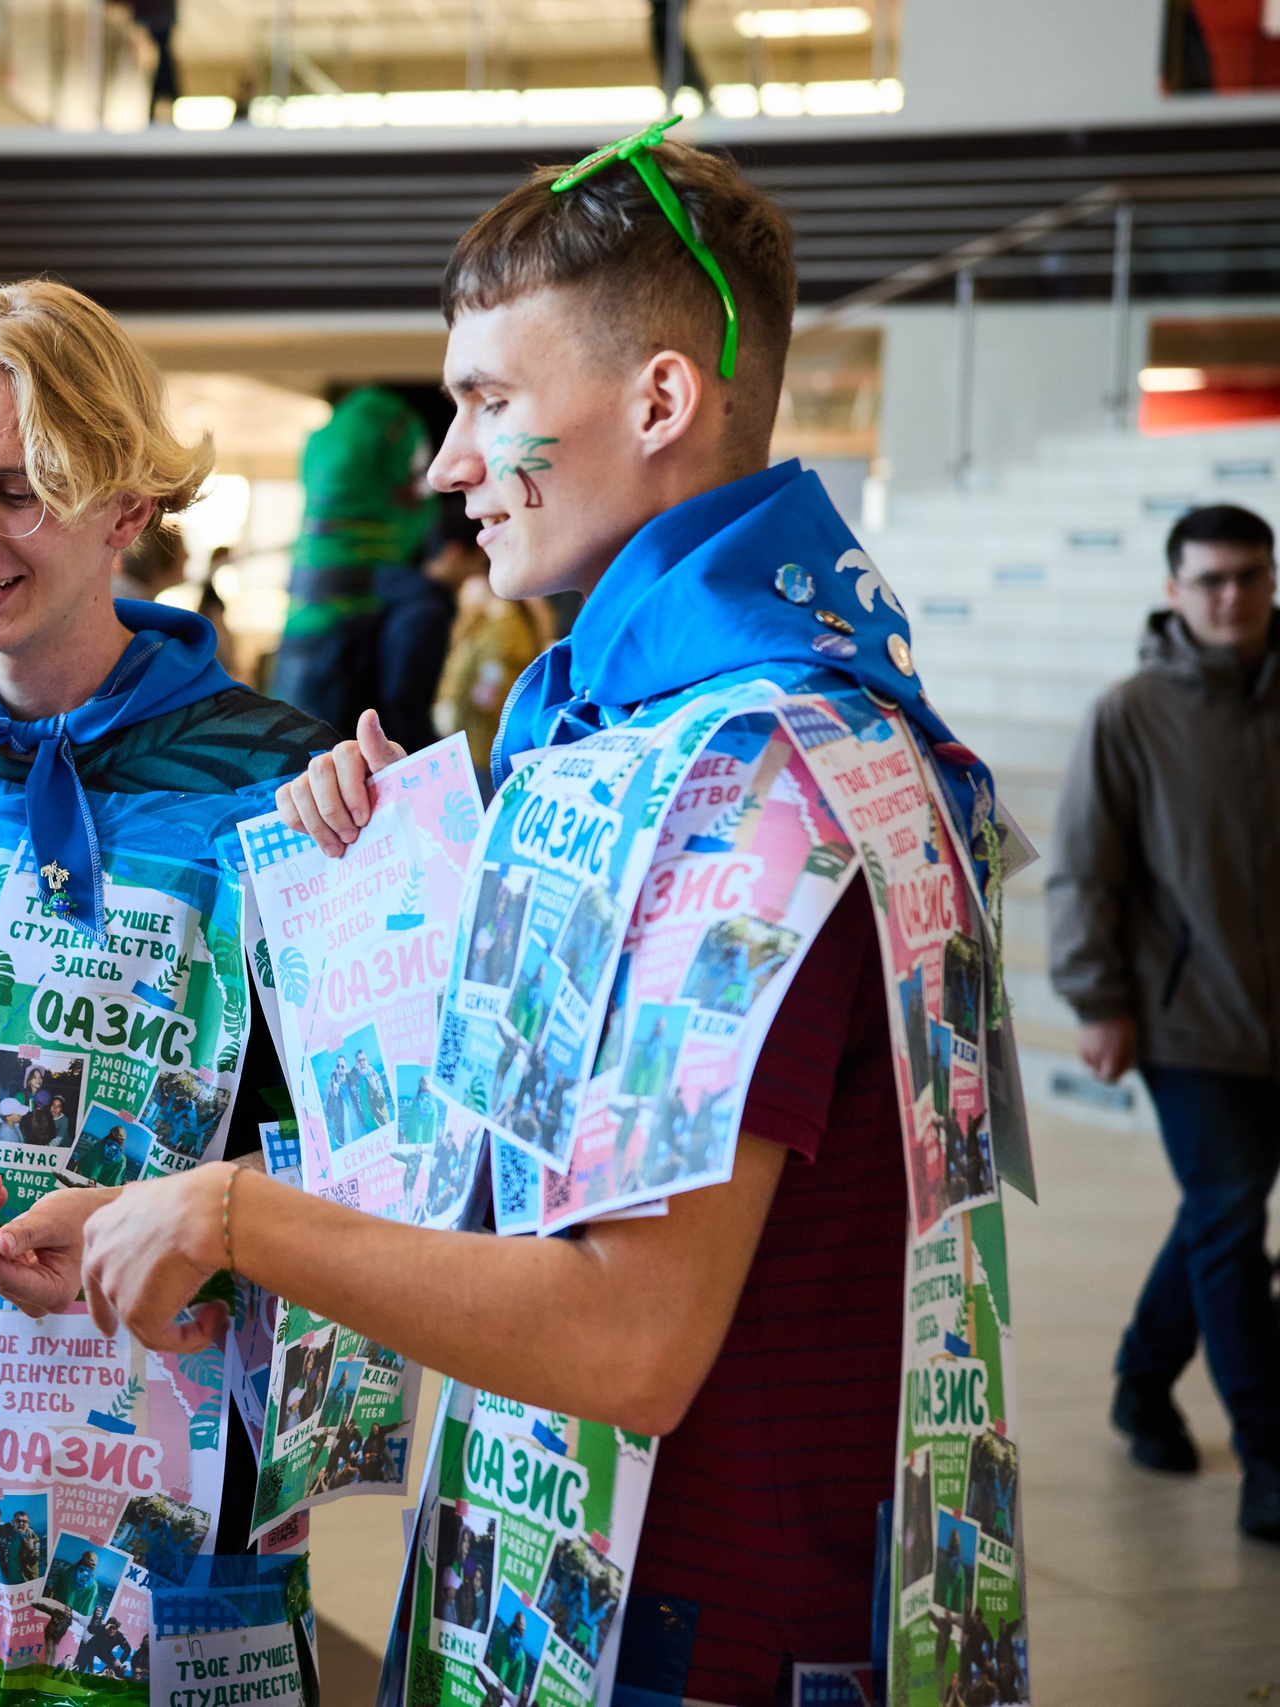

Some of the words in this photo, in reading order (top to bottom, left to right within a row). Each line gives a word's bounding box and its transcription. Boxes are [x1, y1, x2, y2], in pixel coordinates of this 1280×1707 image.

[518, 794, 614, 875] ОАЗИС
[279, 872, 329, 908] ТВОЕ
[335, 834, 397, 886] ЛУЧШЕЕ
[281, 861, 408, 940] СТУДЕНЧЕСТВО
[900, 874, 952, 938] ОАЗИС
[104, 907, 175, 935] УЧШЕЕ
[326, 909, 375, 951] ЗДЕСЬ
[10, 920, 176, 963] СТУДЕНЕСТВО
[51, 954, 123, 981] ЗДЕСЬ
[327, 929, 450, 1014] ОАЗИС
[36, 989, 189, 1066] ОАЗИС
[91, 1068, 146, 1093] РАБОТА
[93, 1055, 150, 1080] ЭМОЦИИ
[94, 1084, 136, 1104] ДЕТИ
[149, 1144, 197, 1171] ЖДЕМ
[343, 1135, 391, 1170] СЕЙЧАС
[5, 1170, 49, 1188] САМОЕ
[27, 1336, 117, 1359] ЛУЧШЕЕ
[338, 1336, 358, 1352] ДЕТИ
[362, 1368, 399, 1387] ЖДЕМ
[3, 1391, 75, 1414] ЗДЕСЬ
[357, 1393, 395, 1406] ИМЕННО
[360, 1408, 386, 1419] ТЕБЯ
[283, 1419, 315, 1451] СЕЙЧАС
[467, 1429, 582, 1529] ОАЗИС
[55, 1486, 118, 1505] ЭМОЦИИ
[55, 1499, 115, 1516] РАБОТА
[58, 1512, 108, 1528] ЛЮДИ
[501, 1532, 544, 1566] РАБОТА
[979, 1536, 1013, 1567] ЖДЕМ
[503, 1554, 535, 1582] ДЕТИ
[19, 1643, 43, 1657] ТУТ
[438, 1630, 477, 1660] СЕЙЧАС
[176, 1656, 230, 1681] ТВОЕ
[236, 1643, 294, 1675] ЛУЧШЕЕ
[546, 1636, 592, 1687] ЖДЕМ
[170, 1670, 301, 1707] СТУДЕНЧЕСТВО
